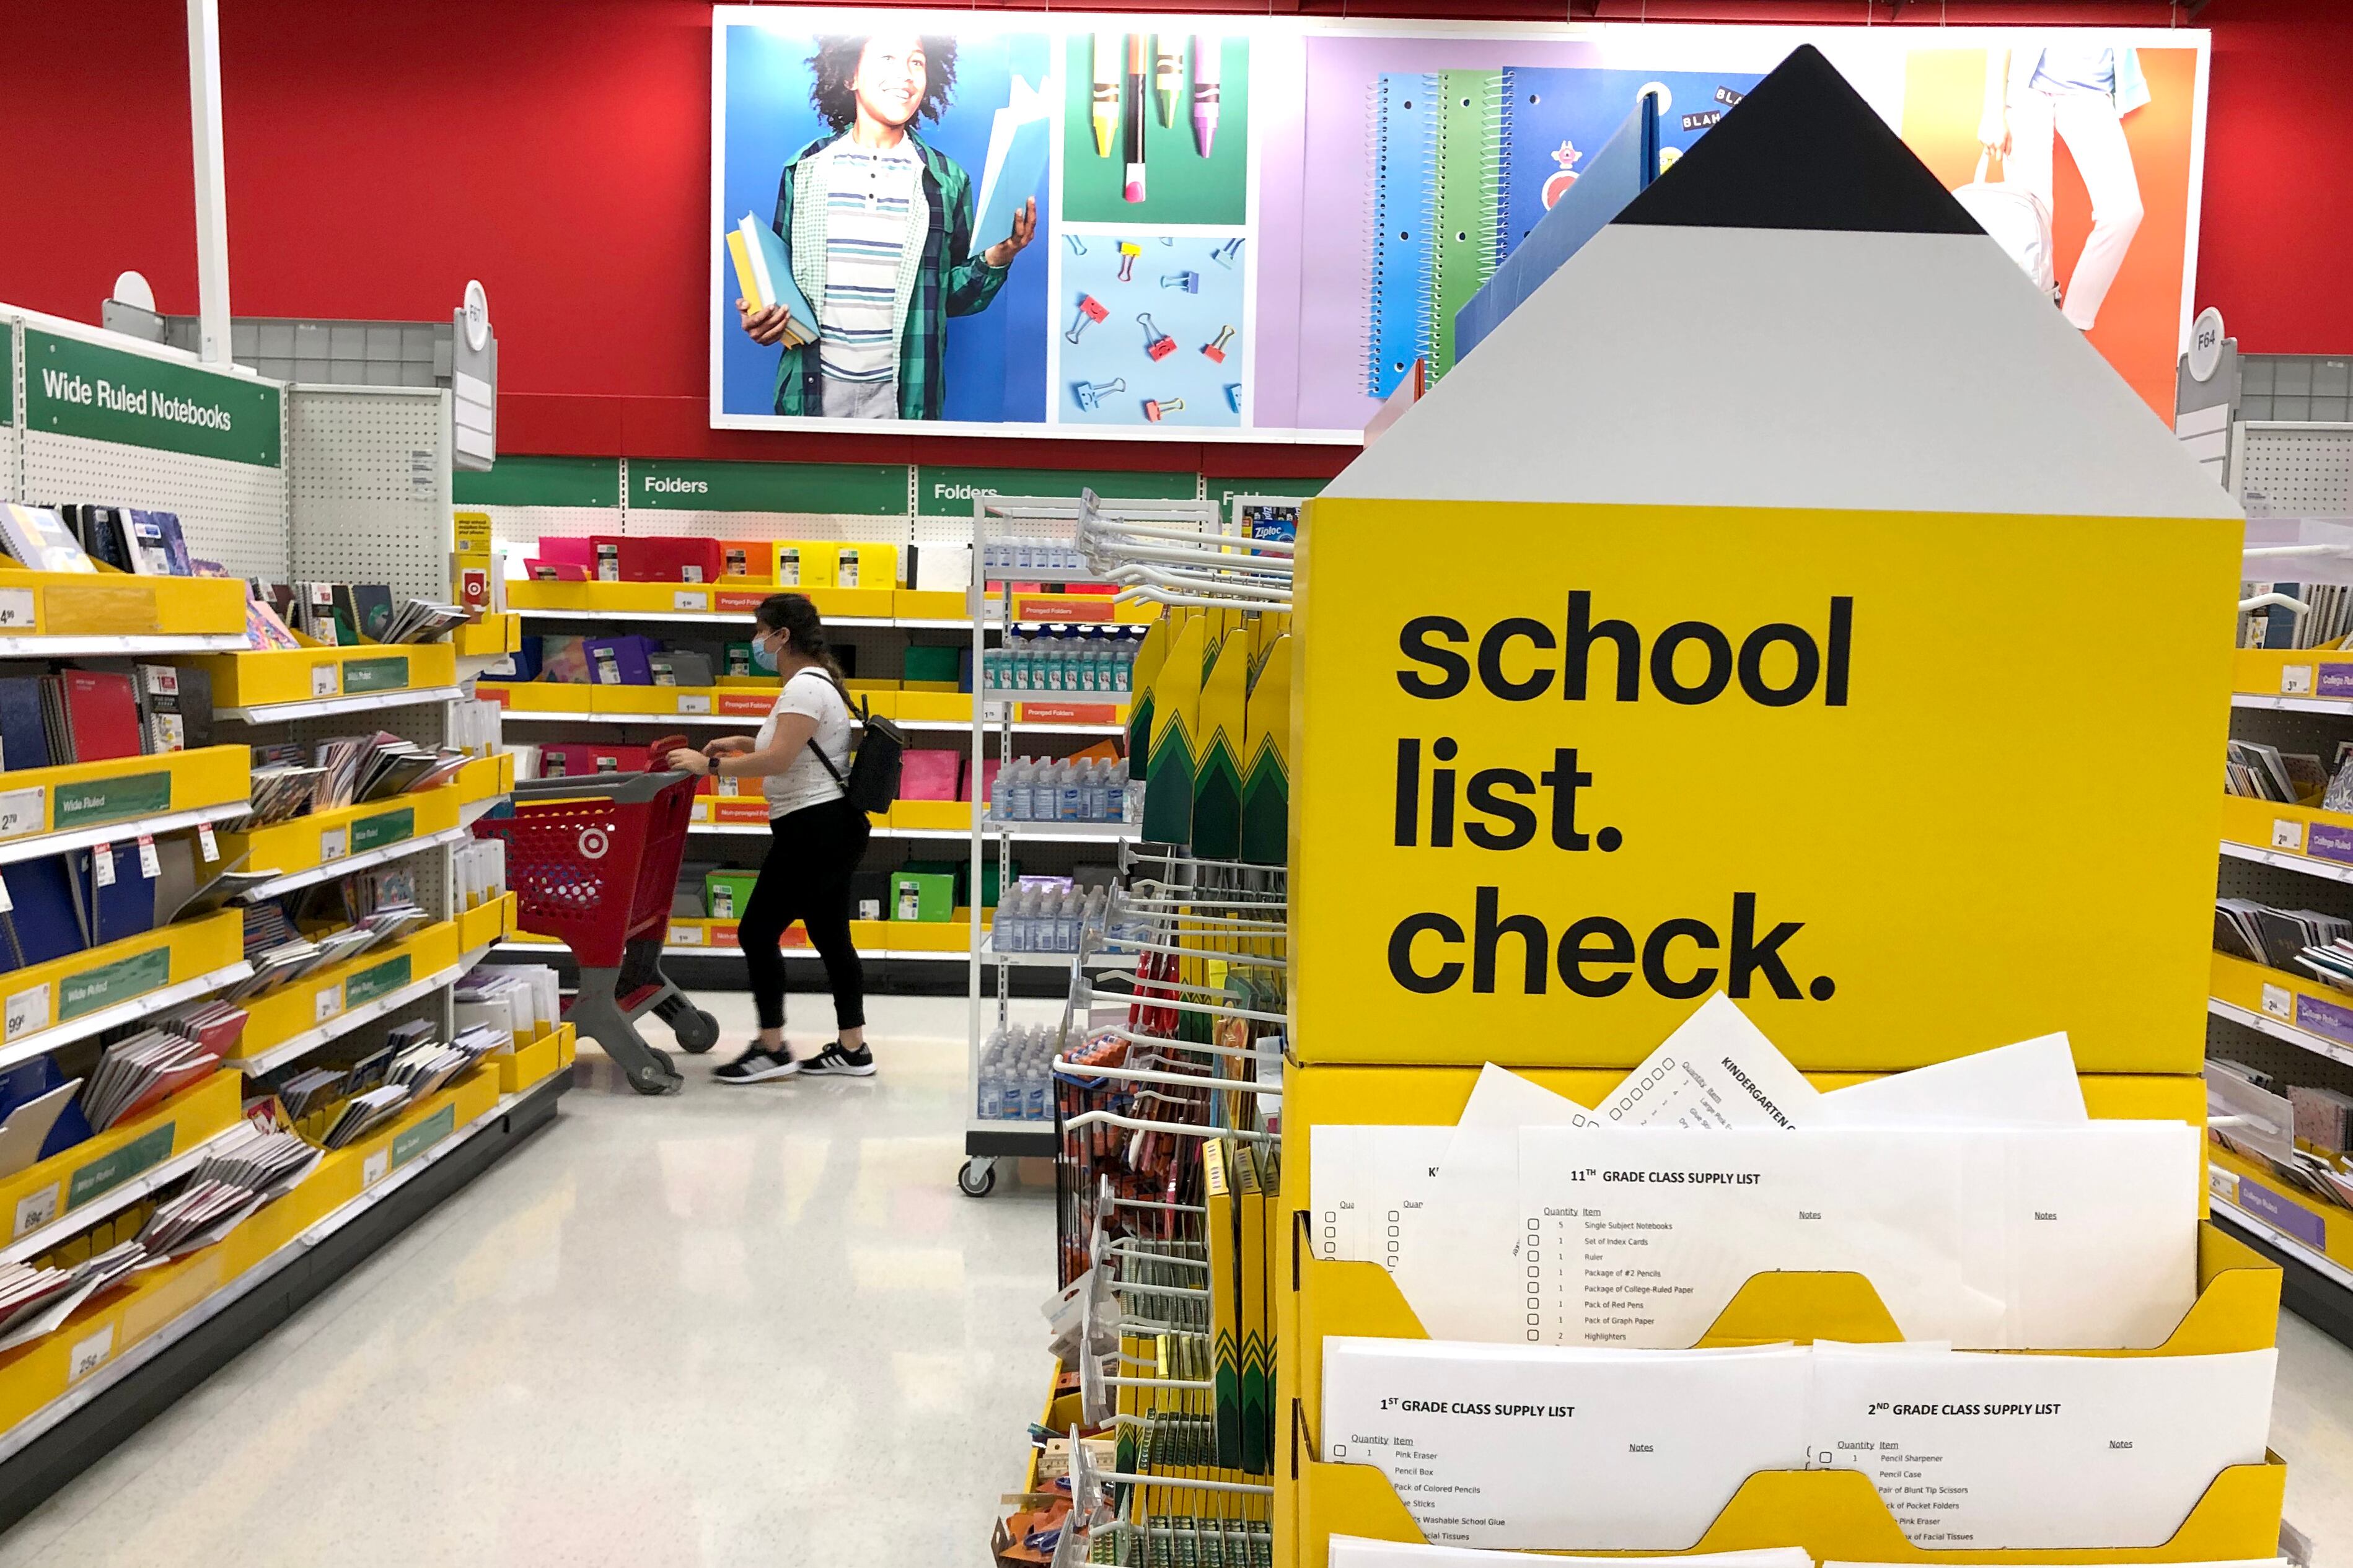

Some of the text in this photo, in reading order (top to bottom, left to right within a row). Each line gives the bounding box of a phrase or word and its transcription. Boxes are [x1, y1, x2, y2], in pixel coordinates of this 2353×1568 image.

[1716, 89, 1742, 105] BLA
[1682, 113, 1720, 128] BLAH
[2198, 329, 2215, 351] F64
[43, 368, 231, 432] Wide Ruled Notebooks
[645, 476, 708, 494] Folders
[935, 484, 998, 499] Folders
[1255, 526, 1282, 538] Ziploc
[1026, 607, 1050, 615] Pronged
[1397, 590, 1852, 706] school
[1027, 709, 1052, 717] Pronged
[1395, 737, 1622, 852] list.
[63, 794, 105, 813] Wide Ruled
[2313, 835, 2351, 851] College Ruled
[1388, 887, 1835, 1001] check.
[1681, 1061, 1707, 1088] Quantity
[1721, 1056, 1790, 1128] KINDERGARTEN
[1700, 1098, 1715, 1114] Large
[1689, 1108, 1703, 1122] Glue
[1571, 1168, 1761, 1185] 11TH GRADE CLASS SUPPLY LIST
[1544, 1207, 1822, 1220] Quantity Item Notes
[2034, 1212, 2057, 1220] Notes
[1585, 1222, 1606, 1230] Single
[1608, 1222, 1634, 1230] Subject
[1636, 1222, 1673, 1230] Notebooks
[1585, 1269, 1614, 1278] Package
[1585, 1285, 1614, 1294] Package
[1624, 1285, 1672, 1295] College-Ruled
[1674, 1287, 1694, 1295] Paper
[1612, 1317, 1633, 1326] Graph
[1635, 1318, 1655, 1326] Paper
[1585, 1333, 1627, 1342] Highlighters
[1380, 1398, 1575, 1418] 1ST GRADE CLASS SUPPLY LIST
[1868, 1403, 2062, 1415] 2ND GRADE CLASS SUPPLY LIST
[1351, 1434, 1654, 1453] Quantity Item Notes
[1837, 1440, 2133, 1450] Quantity Item Notes
[1396, 1451, 1412, 1459] Pink
[1414, 1452, 1438, 1460] Eraser
[1905, 1455, 1943, 1464] Sharpener
[1395, 1467, 1417, 1475] Pencil
[1394, 1483, 1412, 1491] Pack
[1423, 1484, 1453, 1493] Colored
[1454, 1486, 1481, 1494] Pencils
[1925, 1487, 1937, 1495] Tip
[1423, 1517, 1459, 1525] Washable
[1442, 1533, 1470, 1541] Tissues
